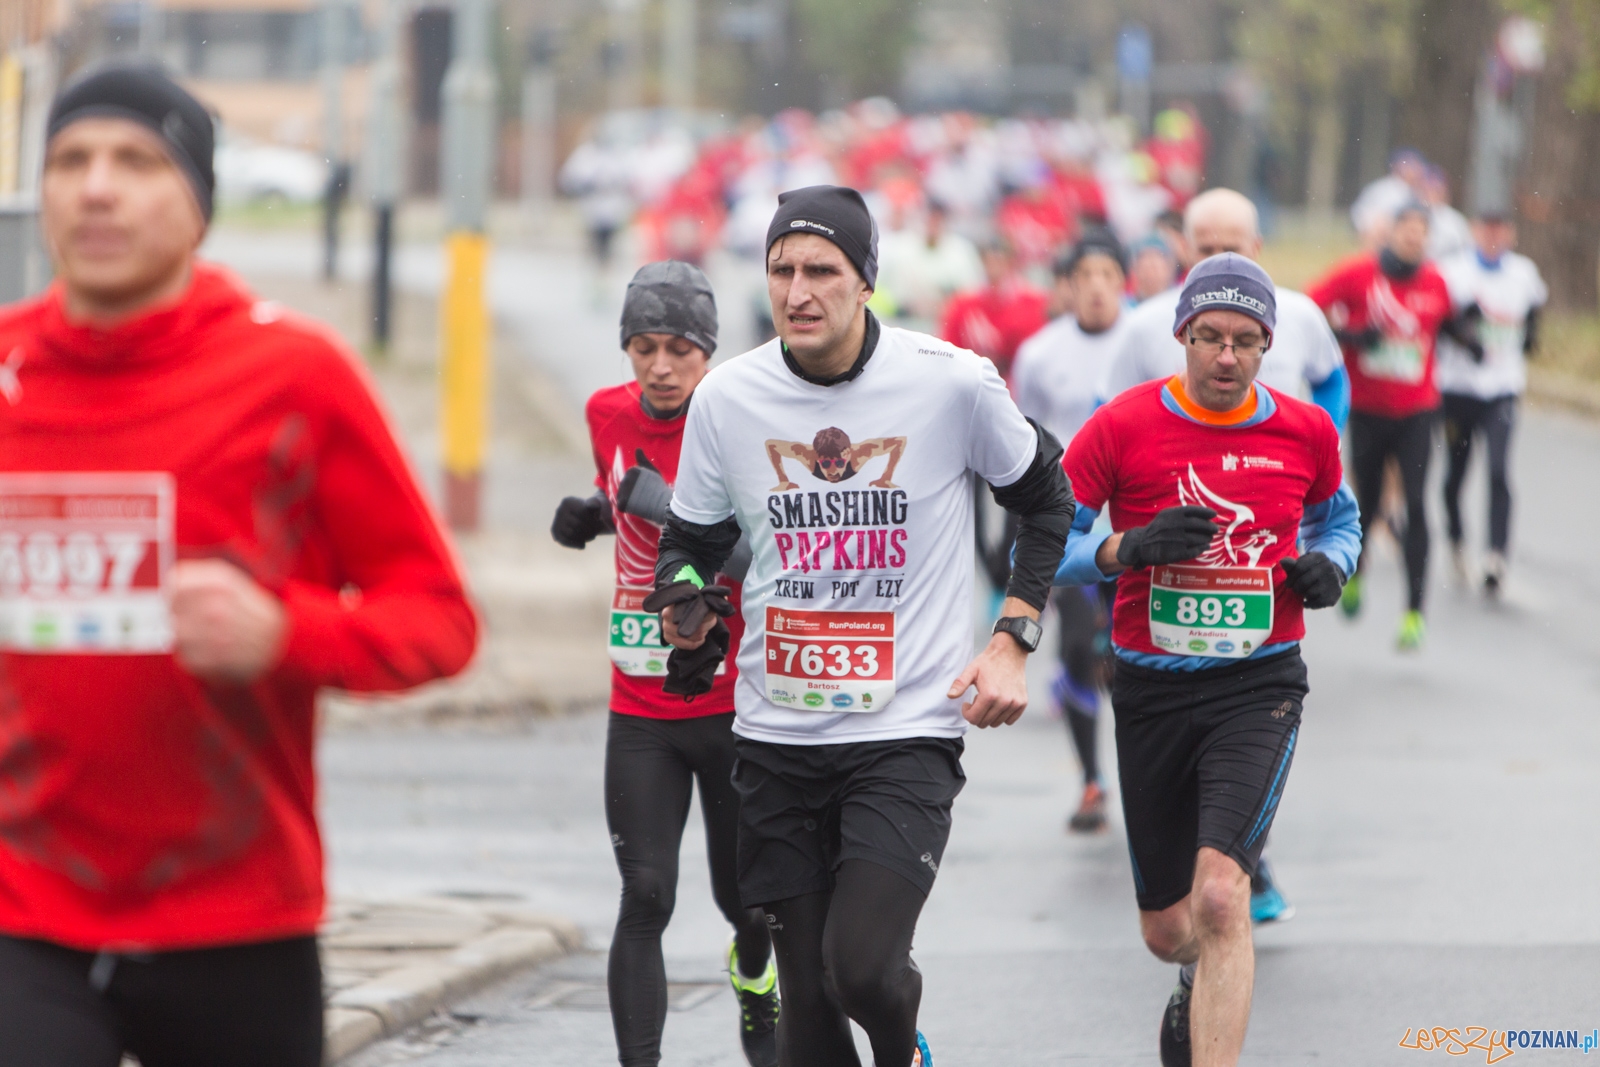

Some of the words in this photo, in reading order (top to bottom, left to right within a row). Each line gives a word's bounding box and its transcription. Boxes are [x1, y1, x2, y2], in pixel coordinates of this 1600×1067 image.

[918, 348, 954, 359] newline
[767, 489, 909, 529] SMASHING
[1216, 577, 1265, 587] RunPoland.org
[831, 580, 860, 599] POT
[1176, 596, 1247, 627] 893
[829, 621, 886, 631] RunPoland.org
[1188, 629, 1228, 638] Arkadiusz
[768, 649, 777, 660] B
[779, 641, 880, 677] 7633
[807, 681, 841, 691] Bartosz
